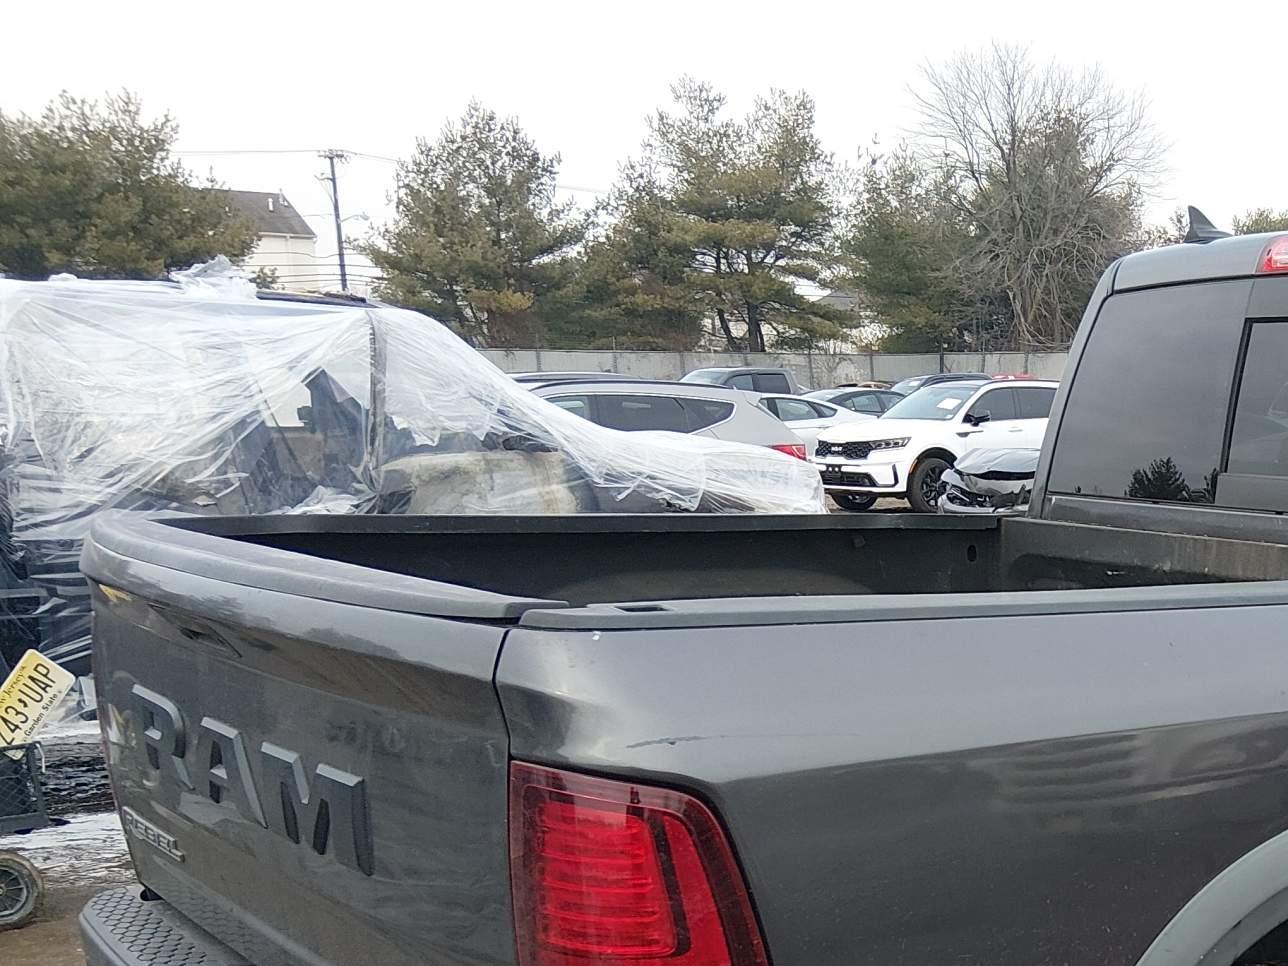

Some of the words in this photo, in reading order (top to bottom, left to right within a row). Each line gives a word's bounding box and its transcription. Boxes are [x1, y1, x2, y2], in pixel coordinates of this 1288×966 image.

[18, 663, 56, 703] UAP
[24, 711, 45, 737] Garden
[41, 693, 58, 712] State
[130, 684, 375, 877] RAM
[121, 806, 186, 862] REBEL
